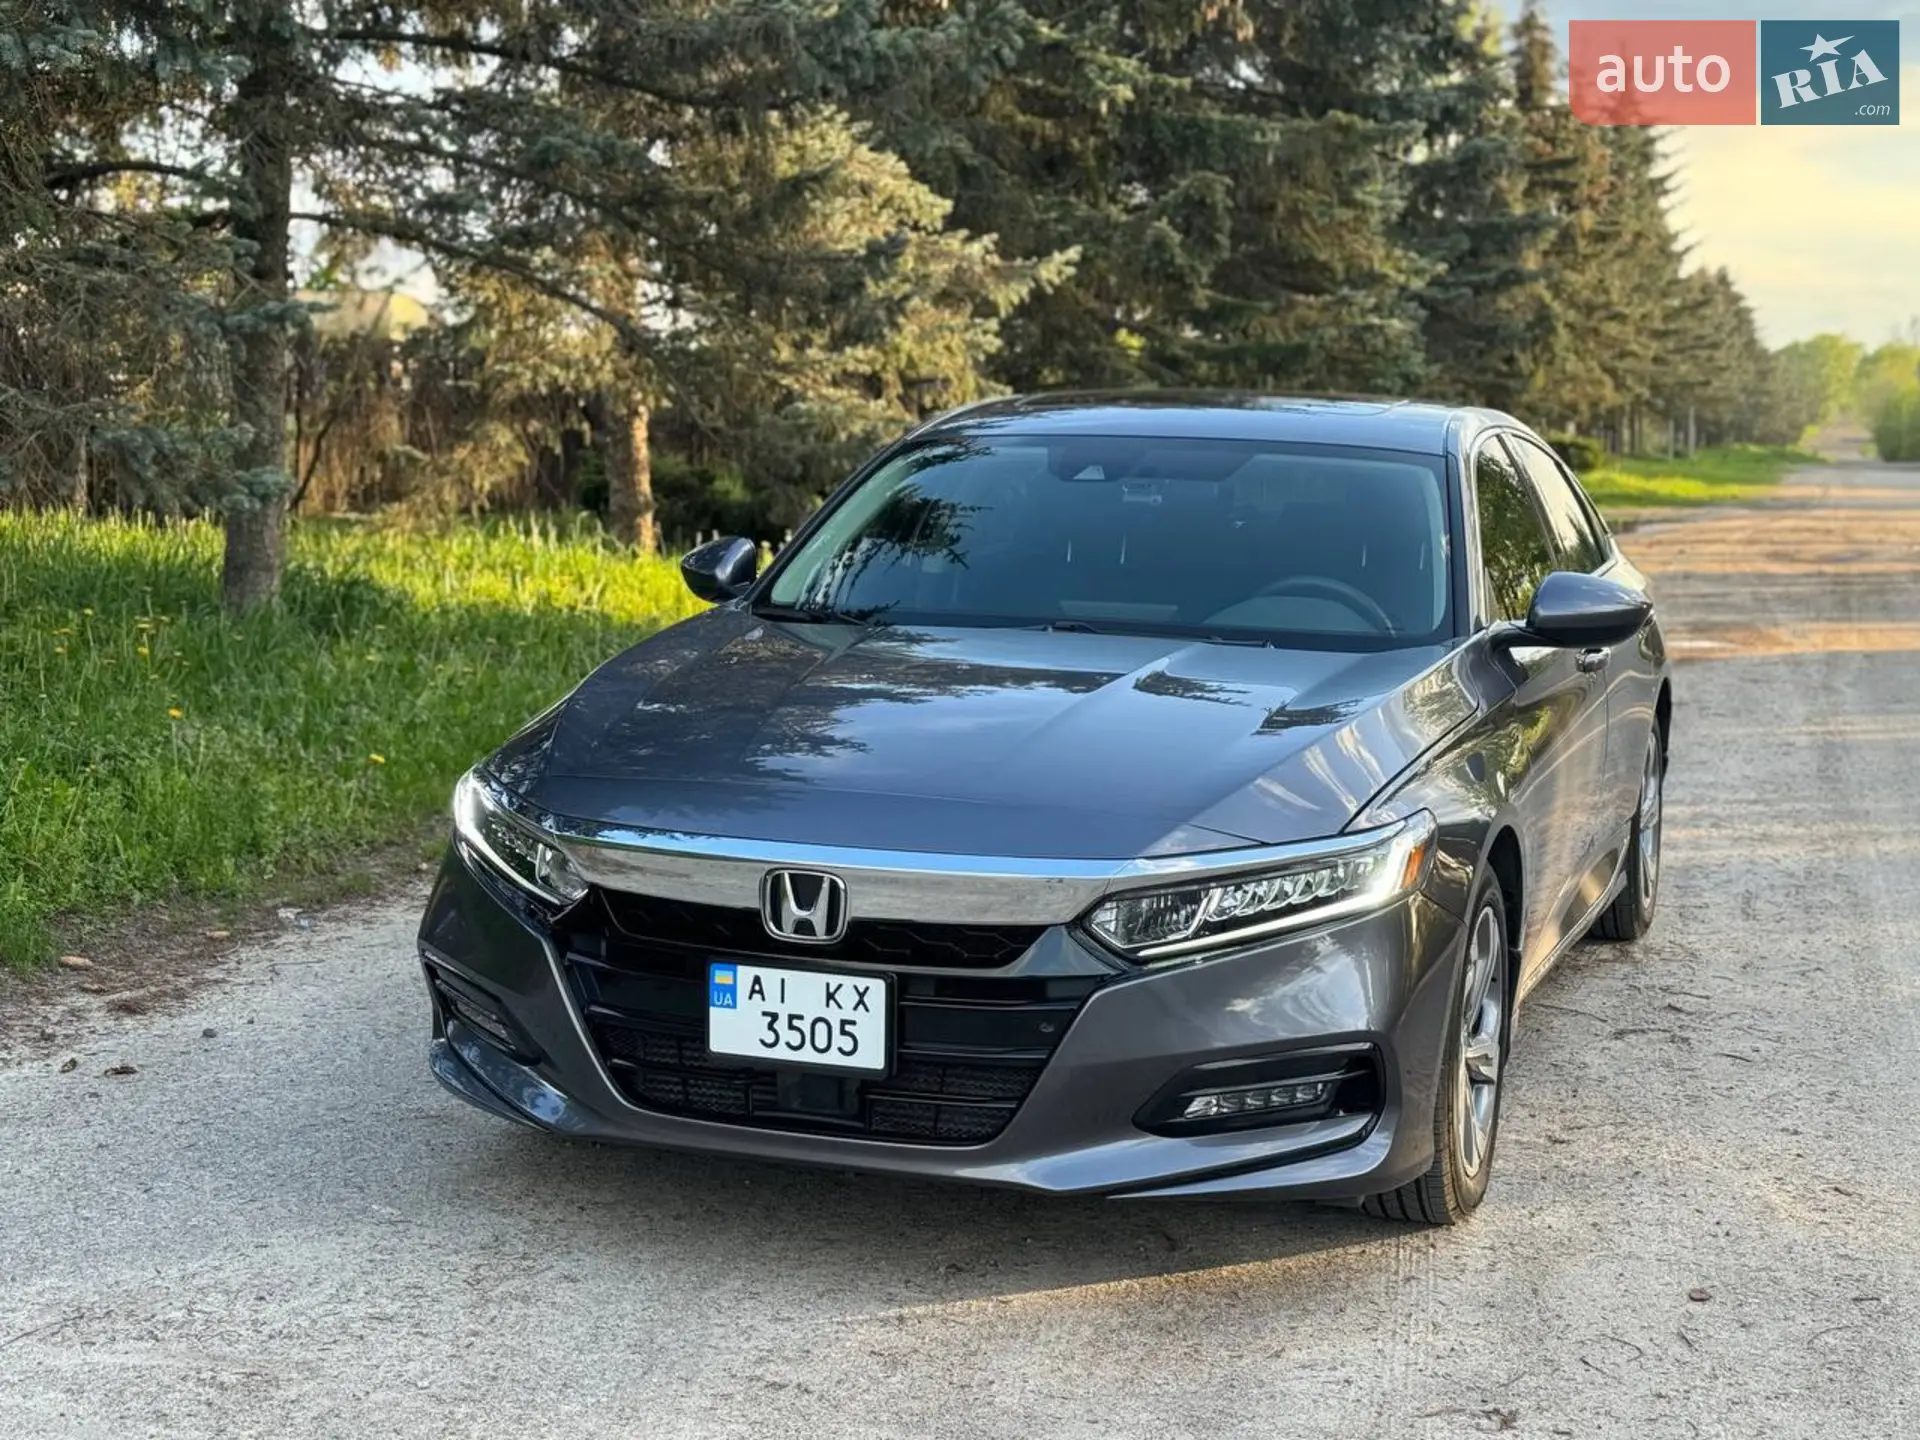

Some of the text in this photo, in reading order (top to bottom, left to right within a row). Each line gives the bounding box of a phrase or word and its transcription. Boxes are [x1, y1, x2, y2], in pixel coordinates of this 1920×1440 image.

[714, 991, 733, 1007] UA
[748, 974, 870, 1013] AI KX
[759, 1010, 859, 1057] 3505
